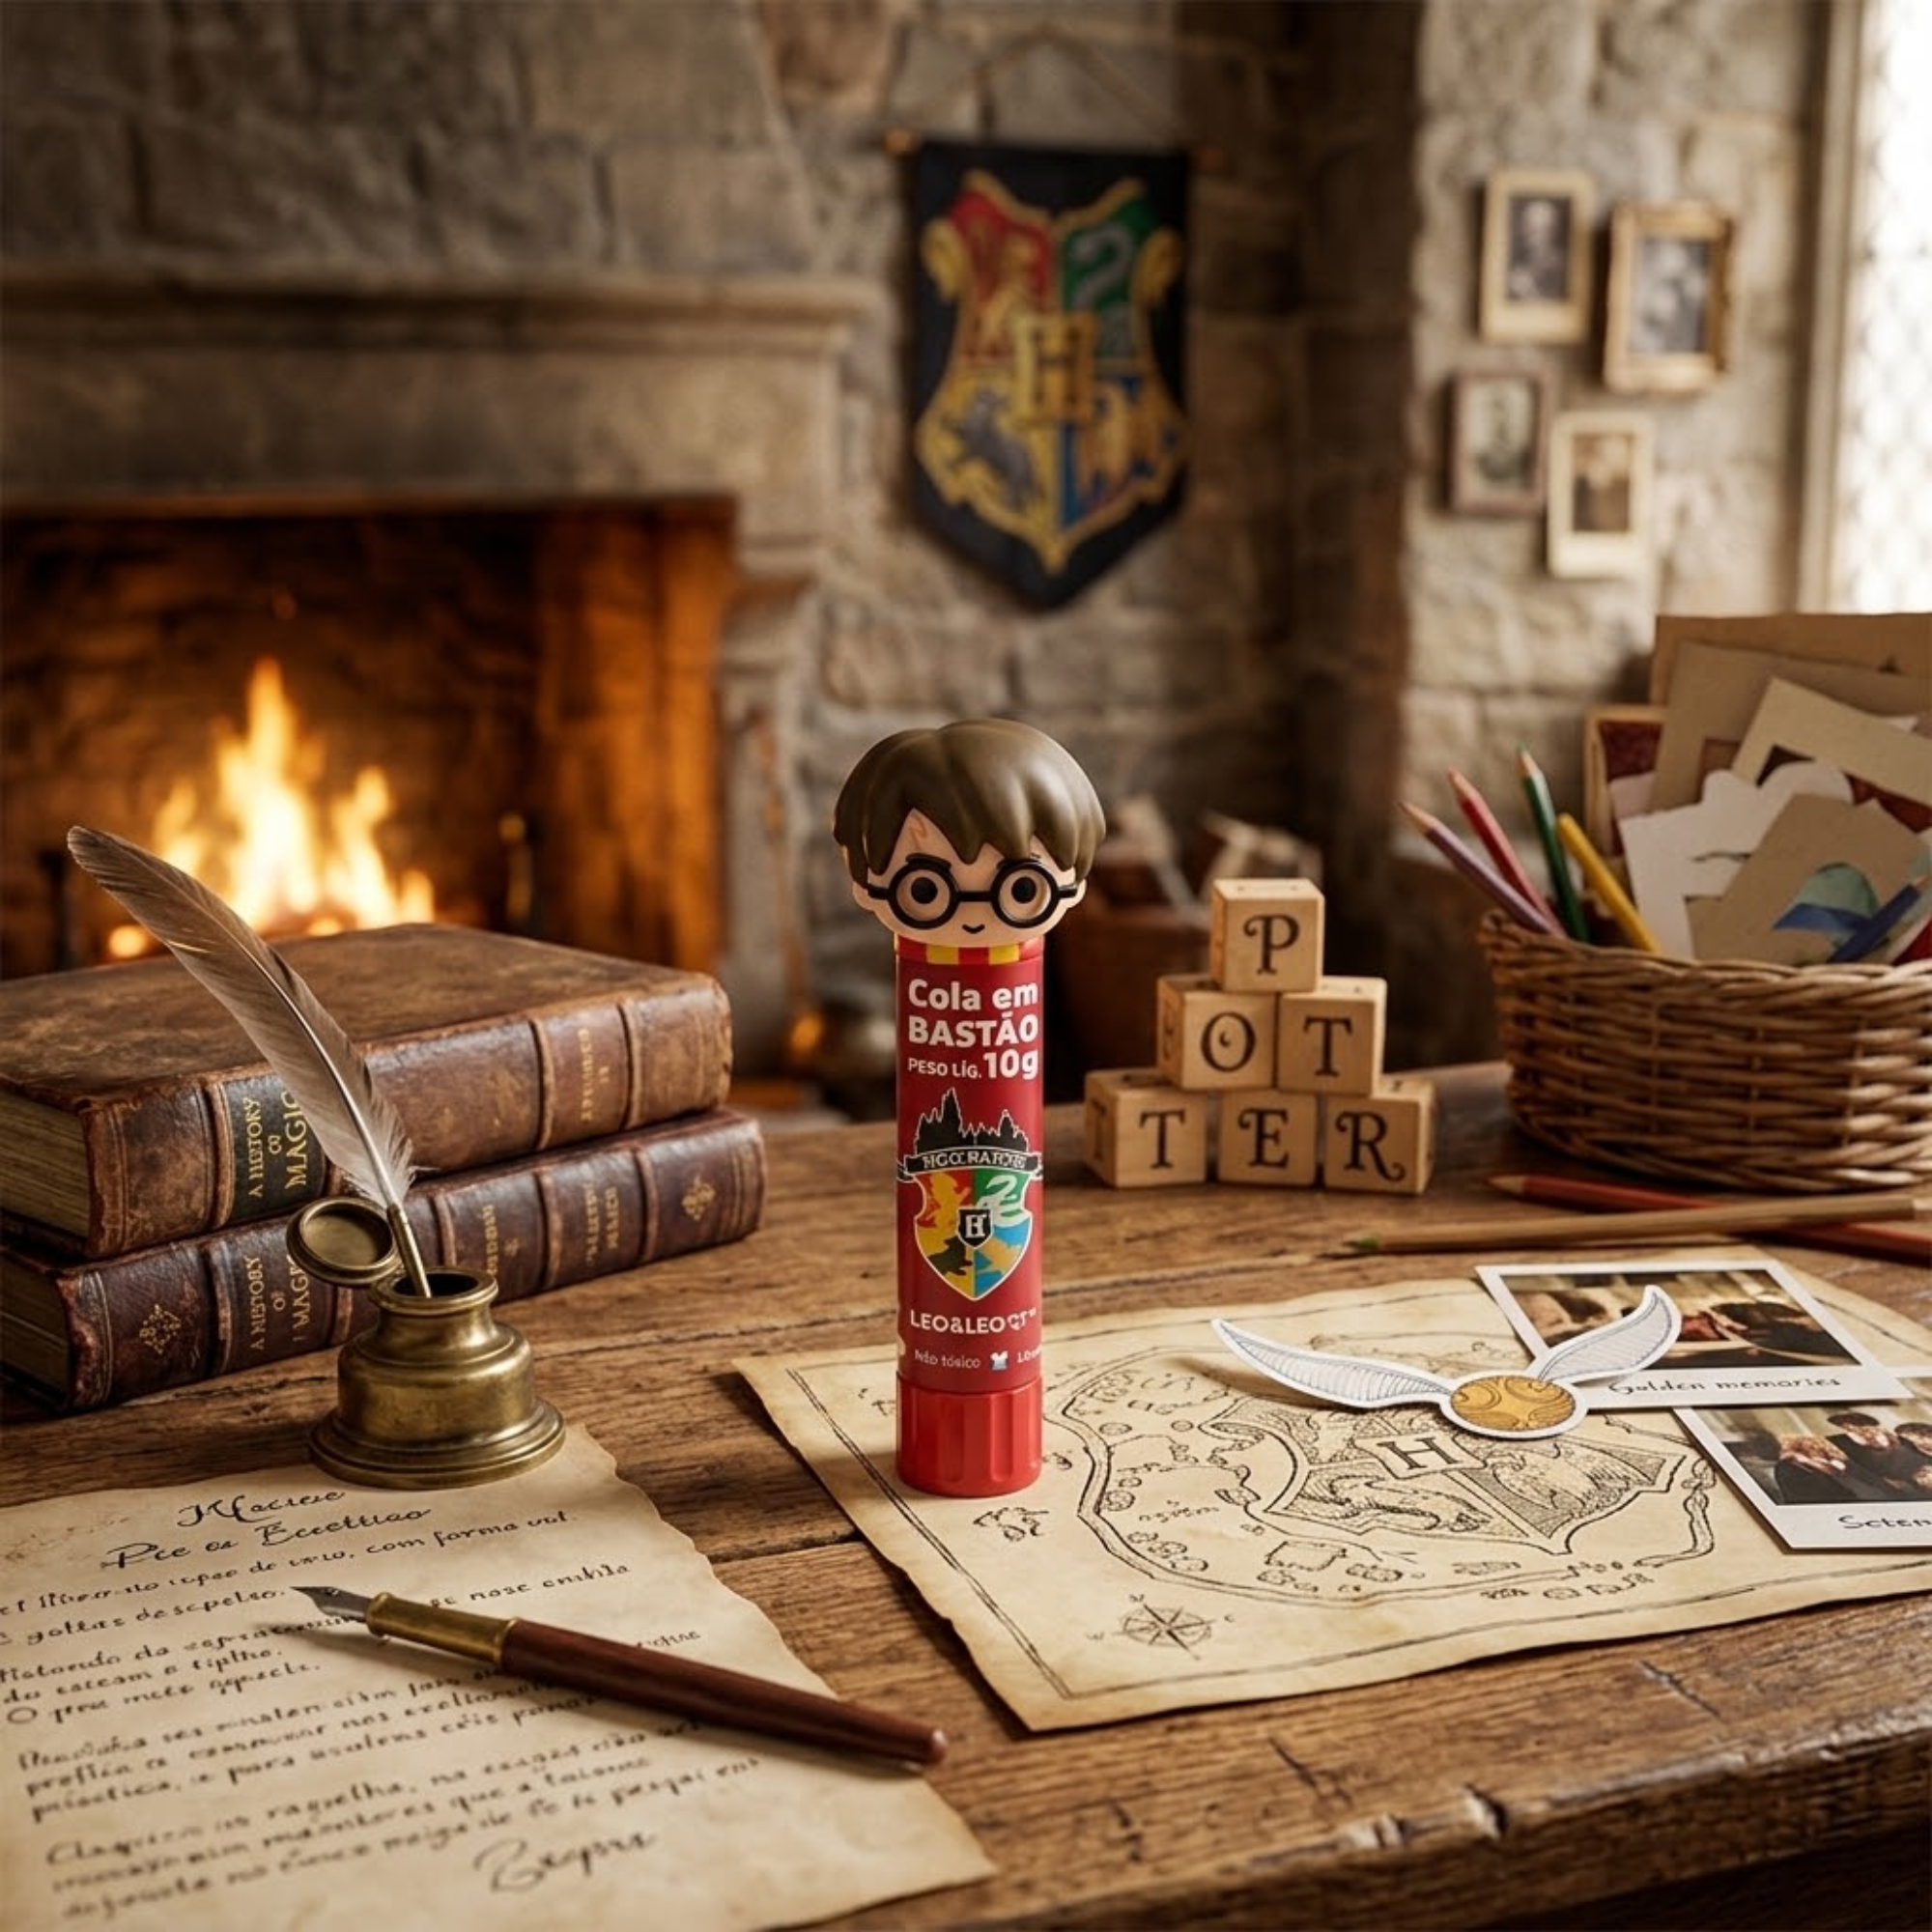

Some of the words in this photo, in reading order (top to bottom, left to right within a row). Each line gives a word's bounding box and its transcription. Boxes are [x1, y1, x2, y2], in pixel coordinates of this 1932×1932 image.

[1243, 914, 1300, 975] P
[908, 979, 981, 1010] Cola
[991, 981, 1039, 1009] em
[908, 1011, 1039, 1048] BASTÃO
[1201, 1011, 1257, 1072] O
[1304, 1017, 1352, 1077] T
[907, 1058, 948, 1076] PESO
[982, 1049, 1039, 1079] 10g
[1140, 1110, 1185, 1170] T
[1238, 1108, 1290, 1170] E
[1335, 1111, 1406, 1181] R
[966, 1213, 986, 1238] H
[1376, 1436, 1464, 1470] H
[366, 1537, 426, 1554] com
